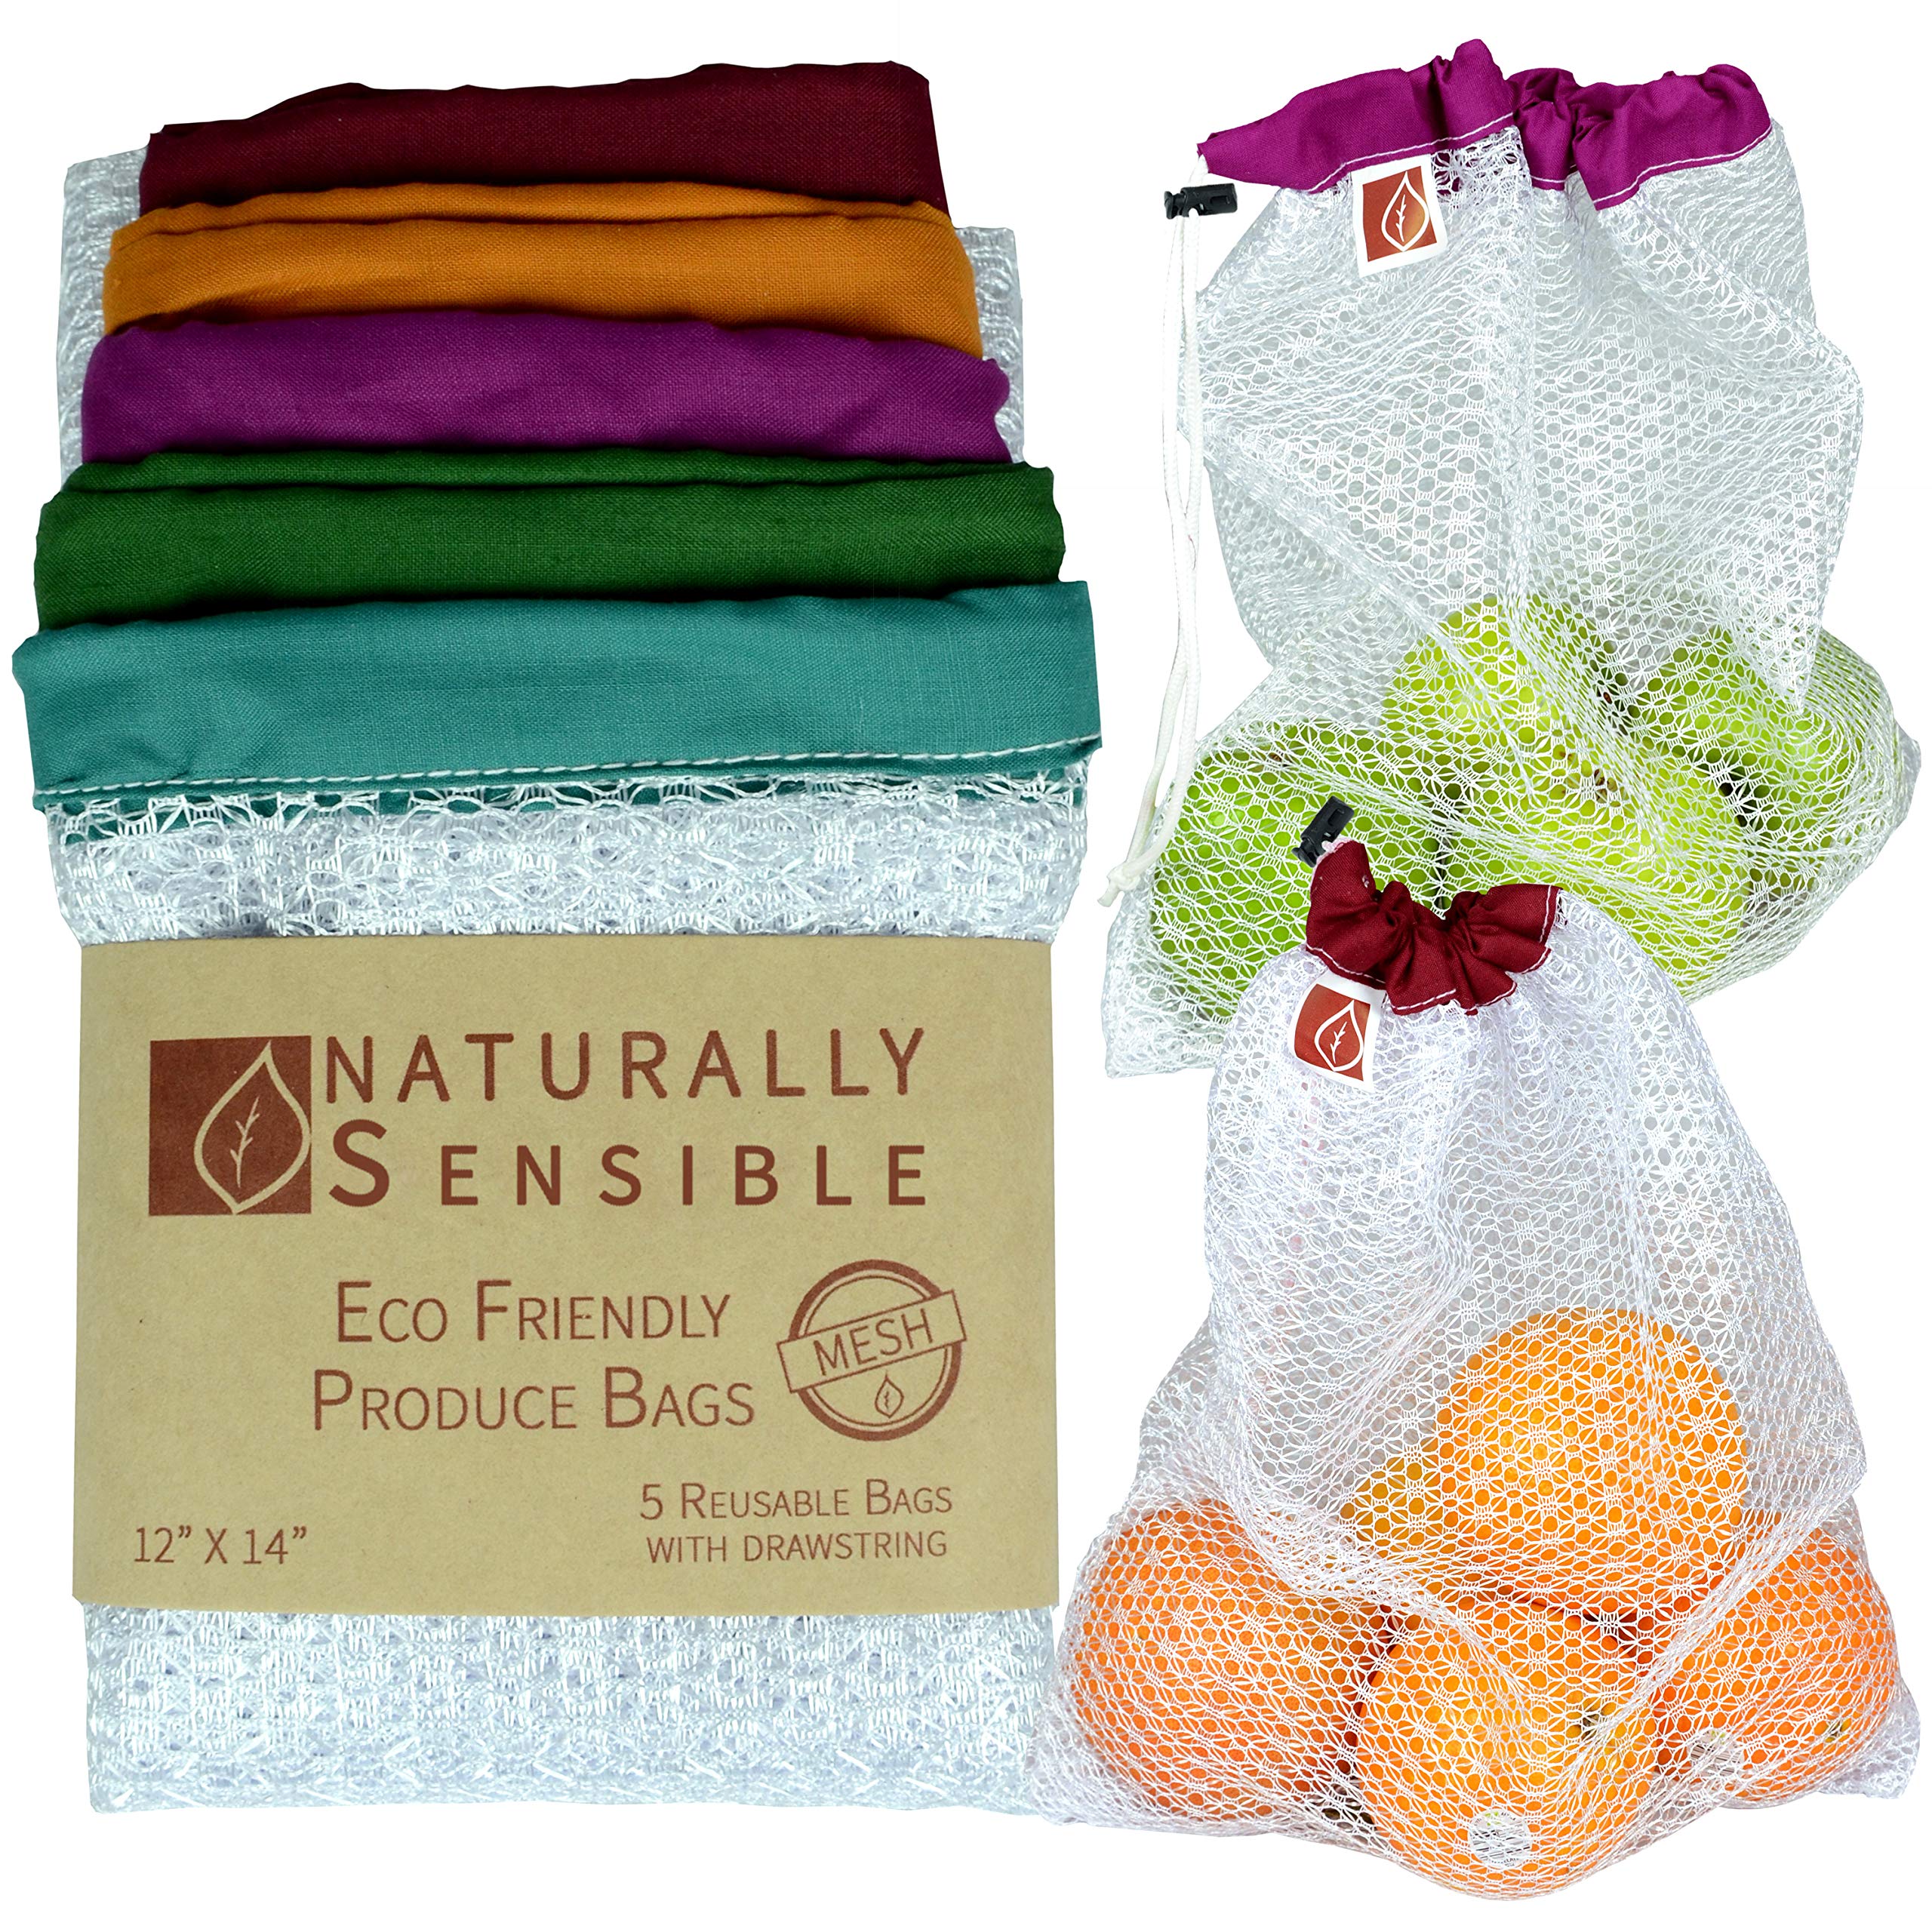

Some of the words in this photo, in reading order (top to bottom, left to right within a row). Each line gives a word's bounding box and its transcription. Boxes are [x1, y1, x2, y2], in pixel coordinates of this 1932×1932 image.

[325, 1028, 925, 1105] NATURALLY
[813, 1308, 934, 1377] MESH
[640, 1483, 664, 1521] 5
[205, 1527, 228, 1565] X
[646, 1535, 728, 1564] WITH
[743, 1531, 949, 1562] DRAWSTRING
